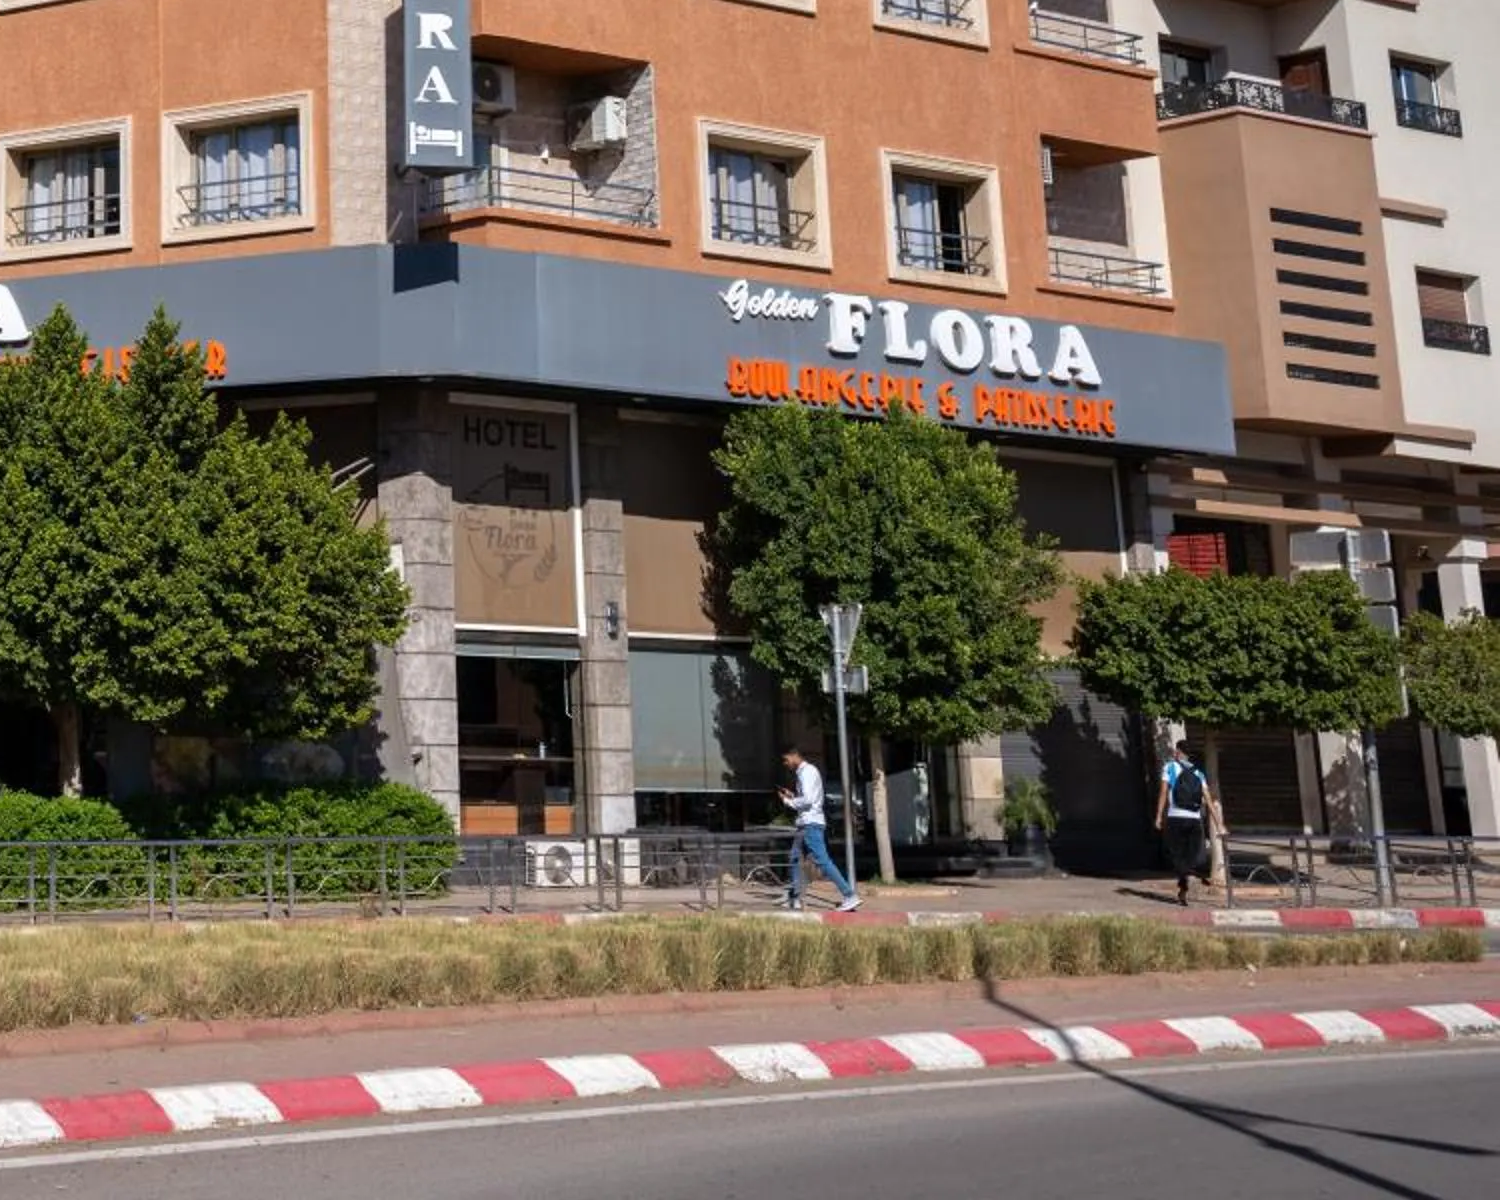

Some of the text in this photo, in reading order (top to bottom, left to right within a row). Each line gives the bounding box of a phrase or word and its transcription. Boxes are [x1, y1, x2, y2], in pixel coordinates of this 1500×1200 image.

[717, 279, 1103, 387] Golden FLORA
[936, 381, 960, 419] &
[463, 415, 557, 450] HOTEL
[484, 524, 539, 550] Flora
